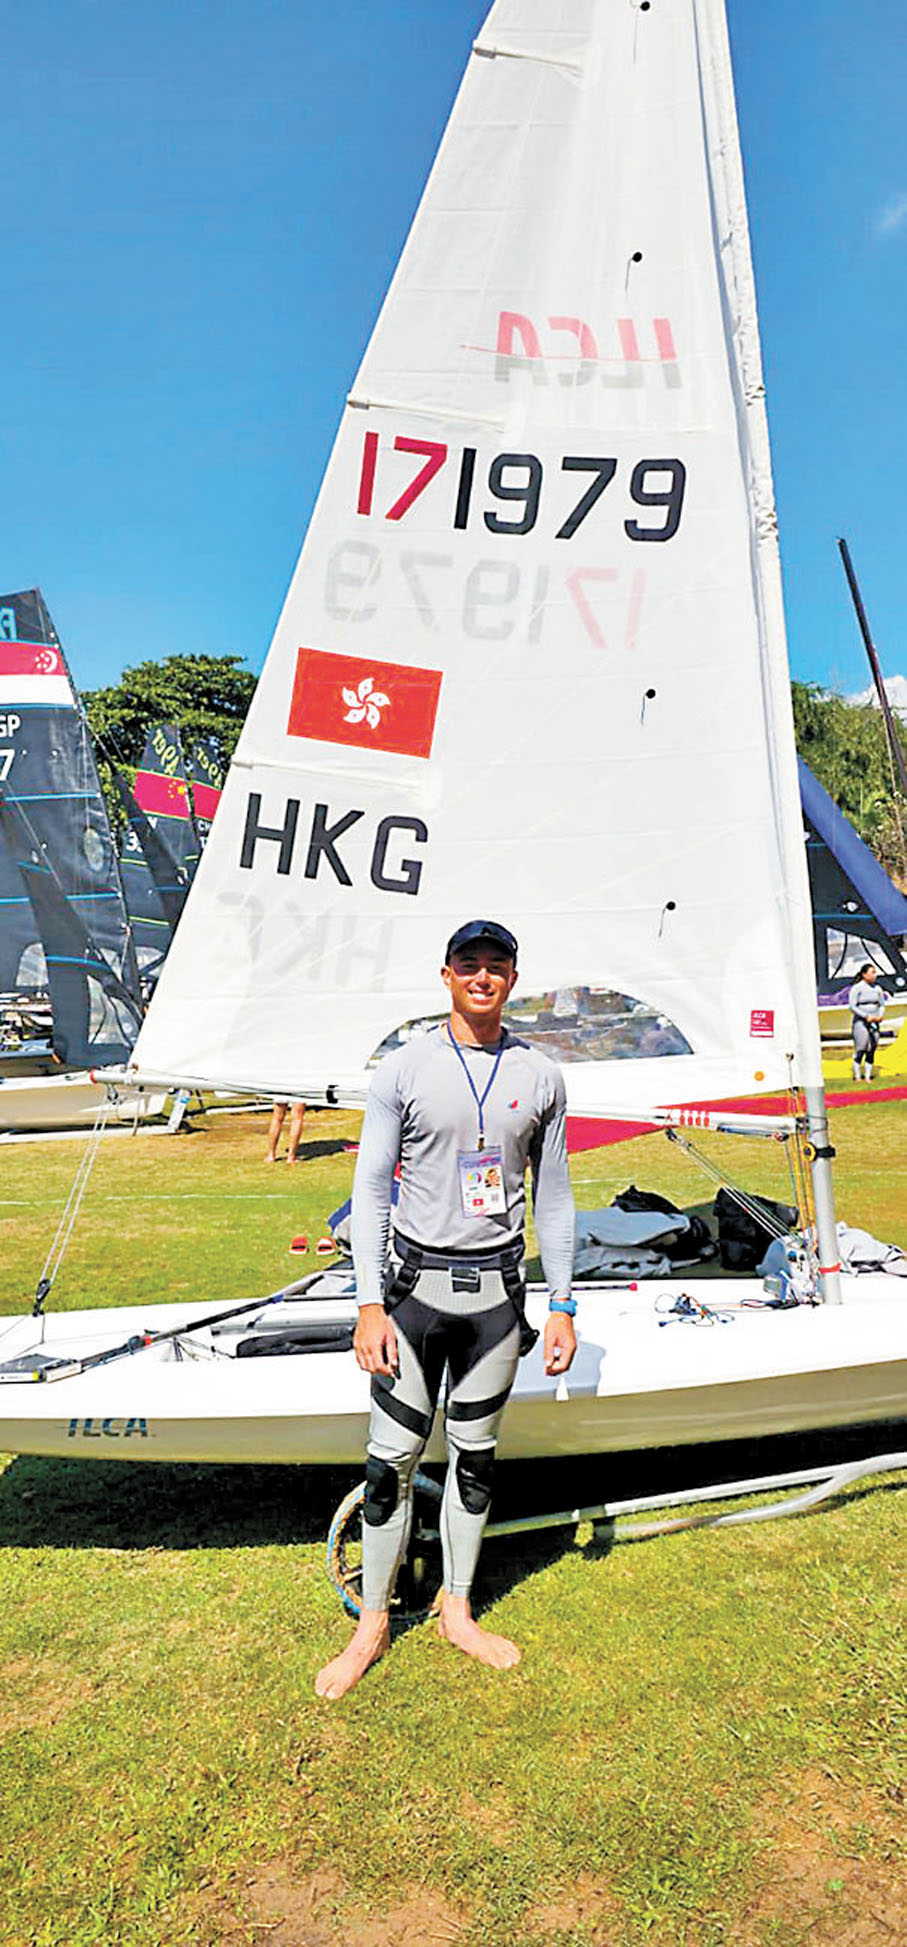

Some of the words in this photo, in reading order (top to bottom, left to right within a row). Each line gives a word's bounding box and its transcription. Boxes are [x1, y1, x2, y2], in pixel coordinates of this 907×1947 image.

[356, 431, 687, 542] 171979
[239, 792, 429, 896] HKG
[67, 1417, 150, 1438] ILCA
